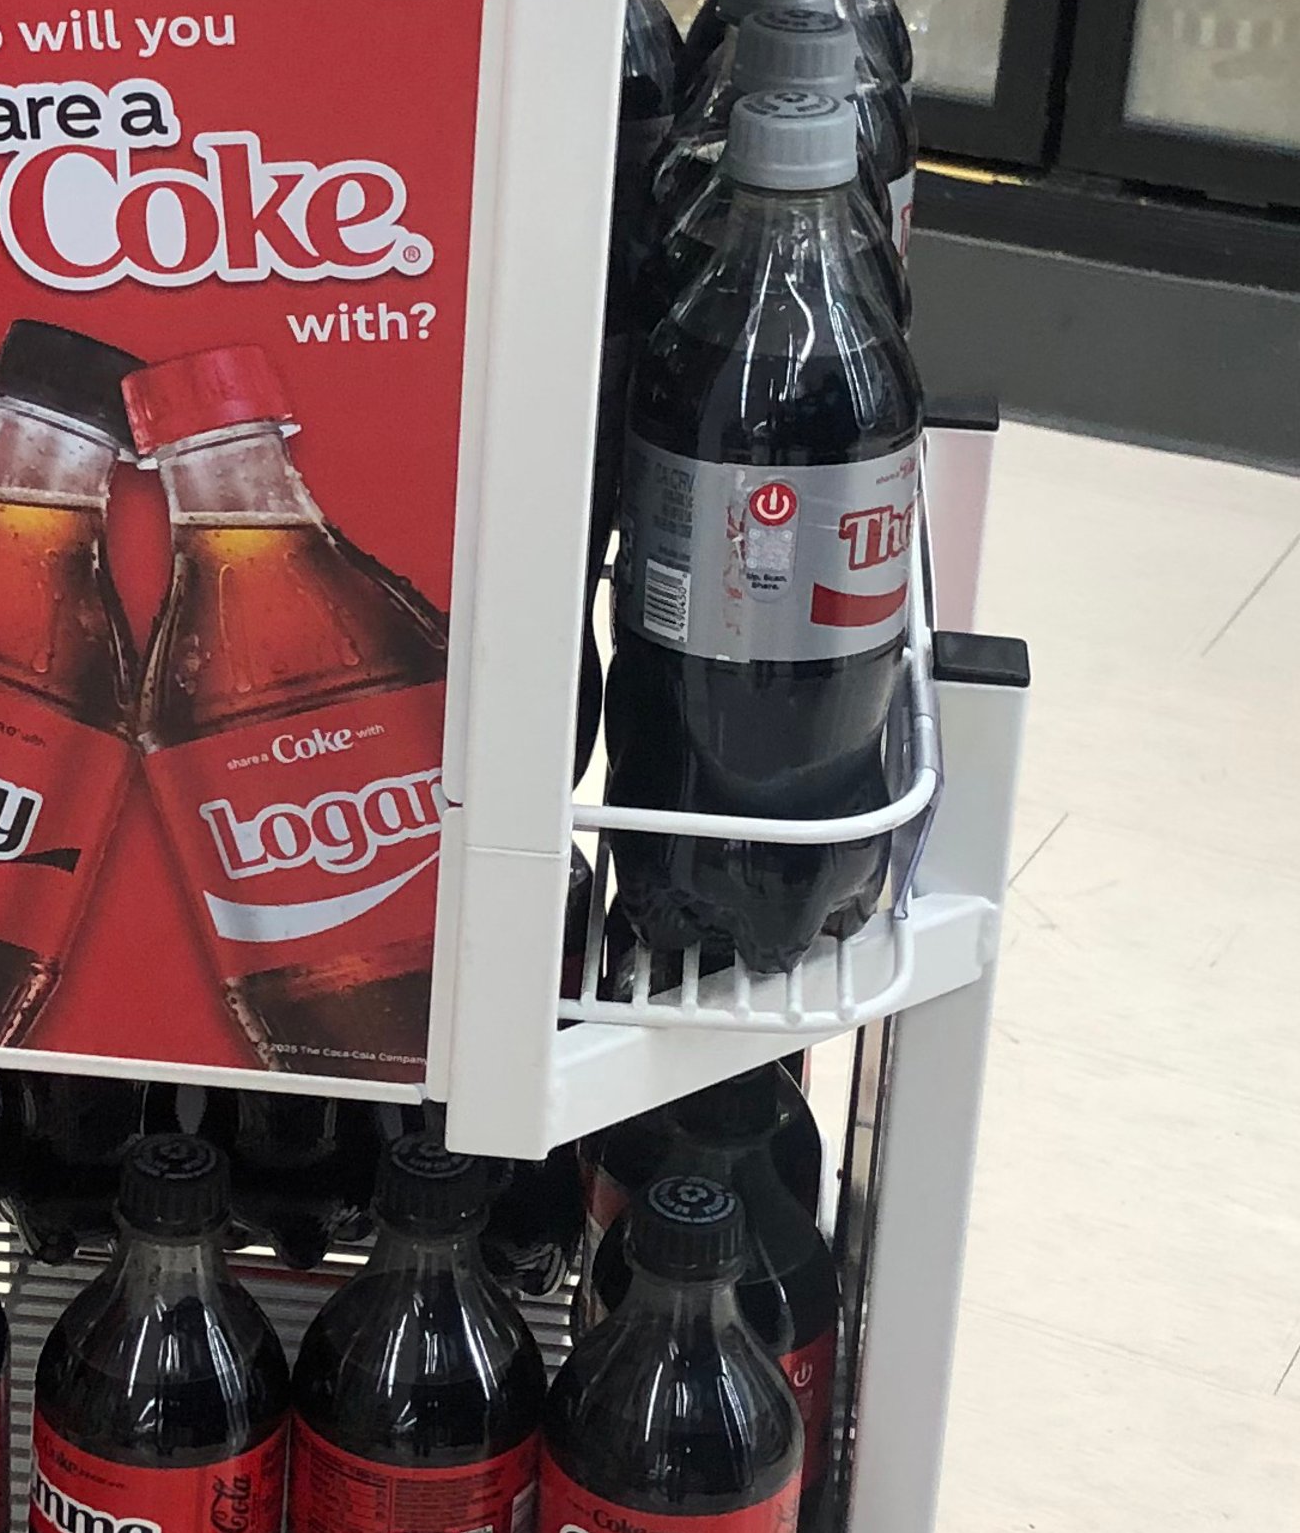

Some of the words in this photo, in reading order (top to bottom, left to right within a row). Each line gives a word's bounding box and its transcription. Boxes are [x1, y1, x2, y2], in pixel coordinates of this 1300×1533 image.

[18, 8, 122, 54] will
[134, 12, 237, 60] you
[120, 90, 169, 139] a
[286, 301, 438, 344] with?
[271, 725, 355, 765] Coke
[270, 1042, 298, 1055] 2025
